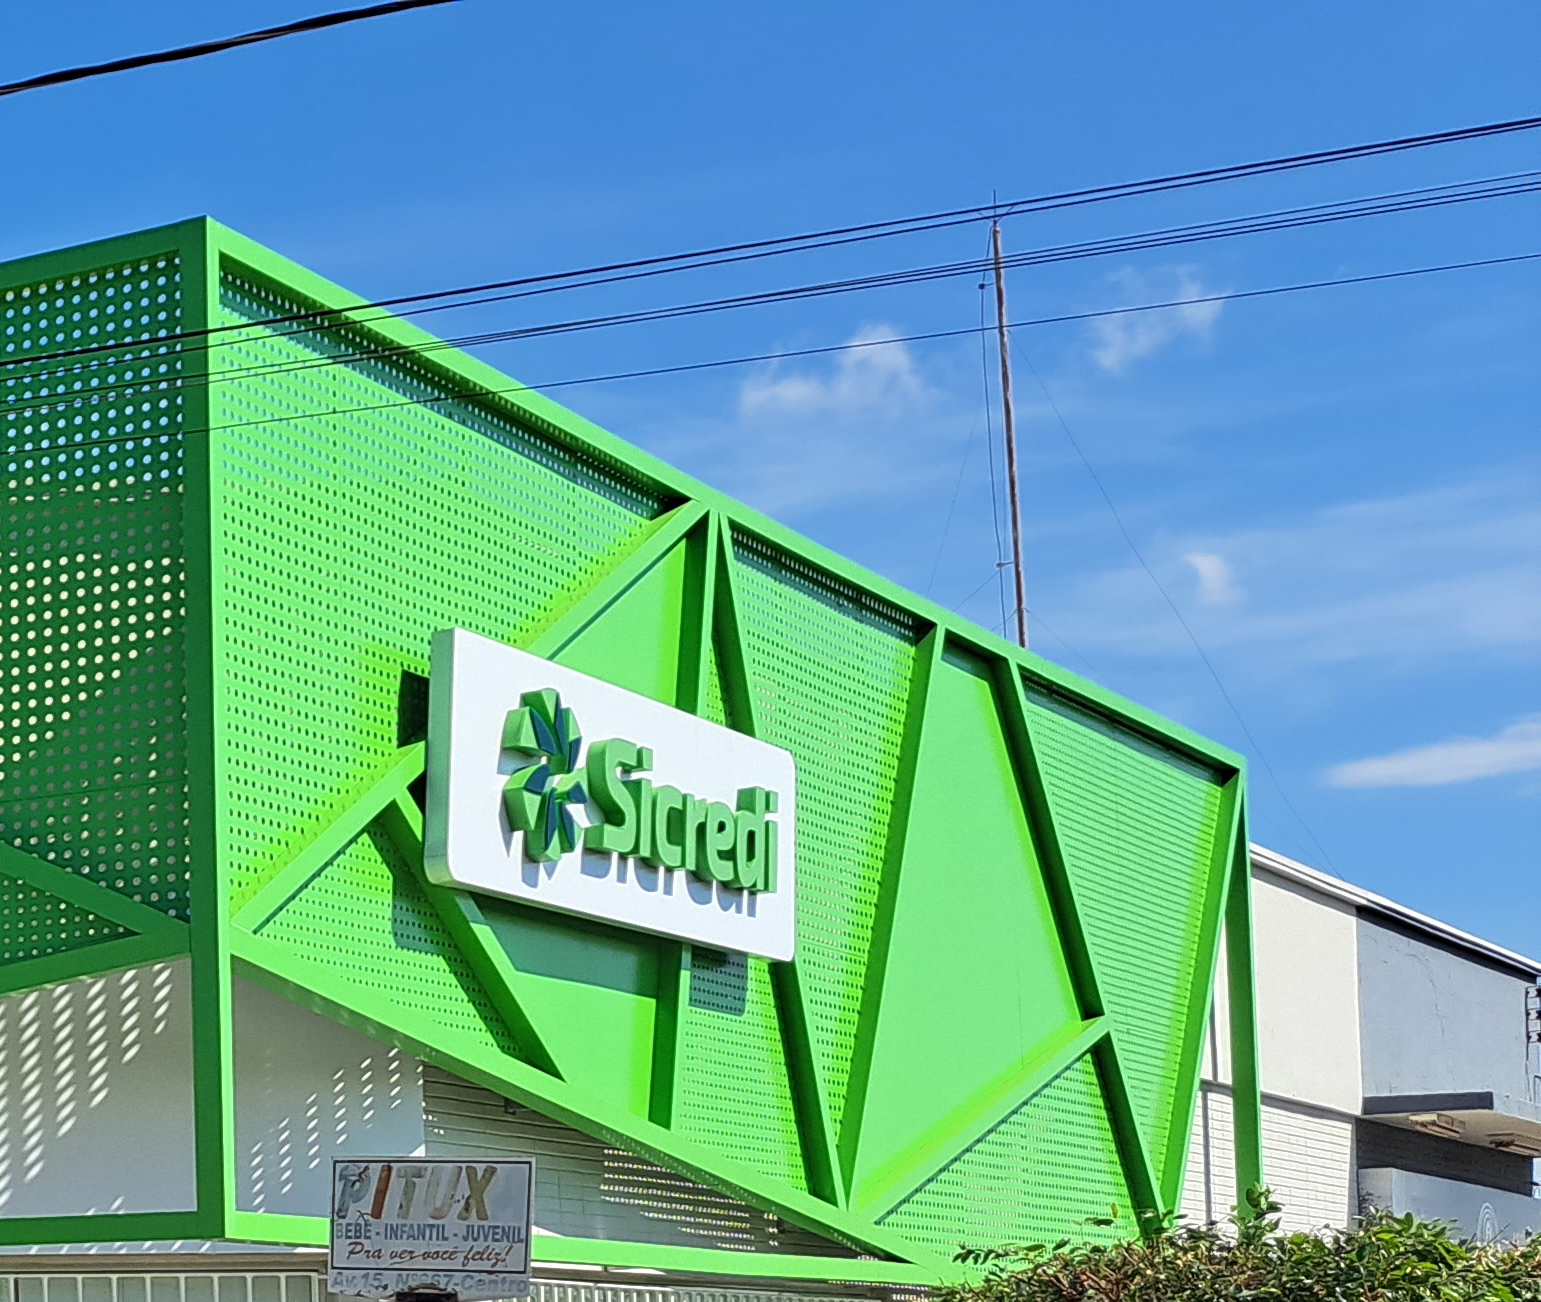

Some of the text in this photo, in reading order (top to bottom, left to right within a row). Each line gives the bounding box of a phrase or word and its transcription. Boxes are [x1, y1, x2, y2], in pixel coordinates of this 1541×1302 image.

[584, 738, 778, 893] Sicredi
[336, 1164, 497, 1221] PITUX
[384, 1222, 449, 1241] INFANTIL
[462, 1224, 525, 1244] JUVENIL
[347, 1241, 514, 1268] Pra ver você feliz!
